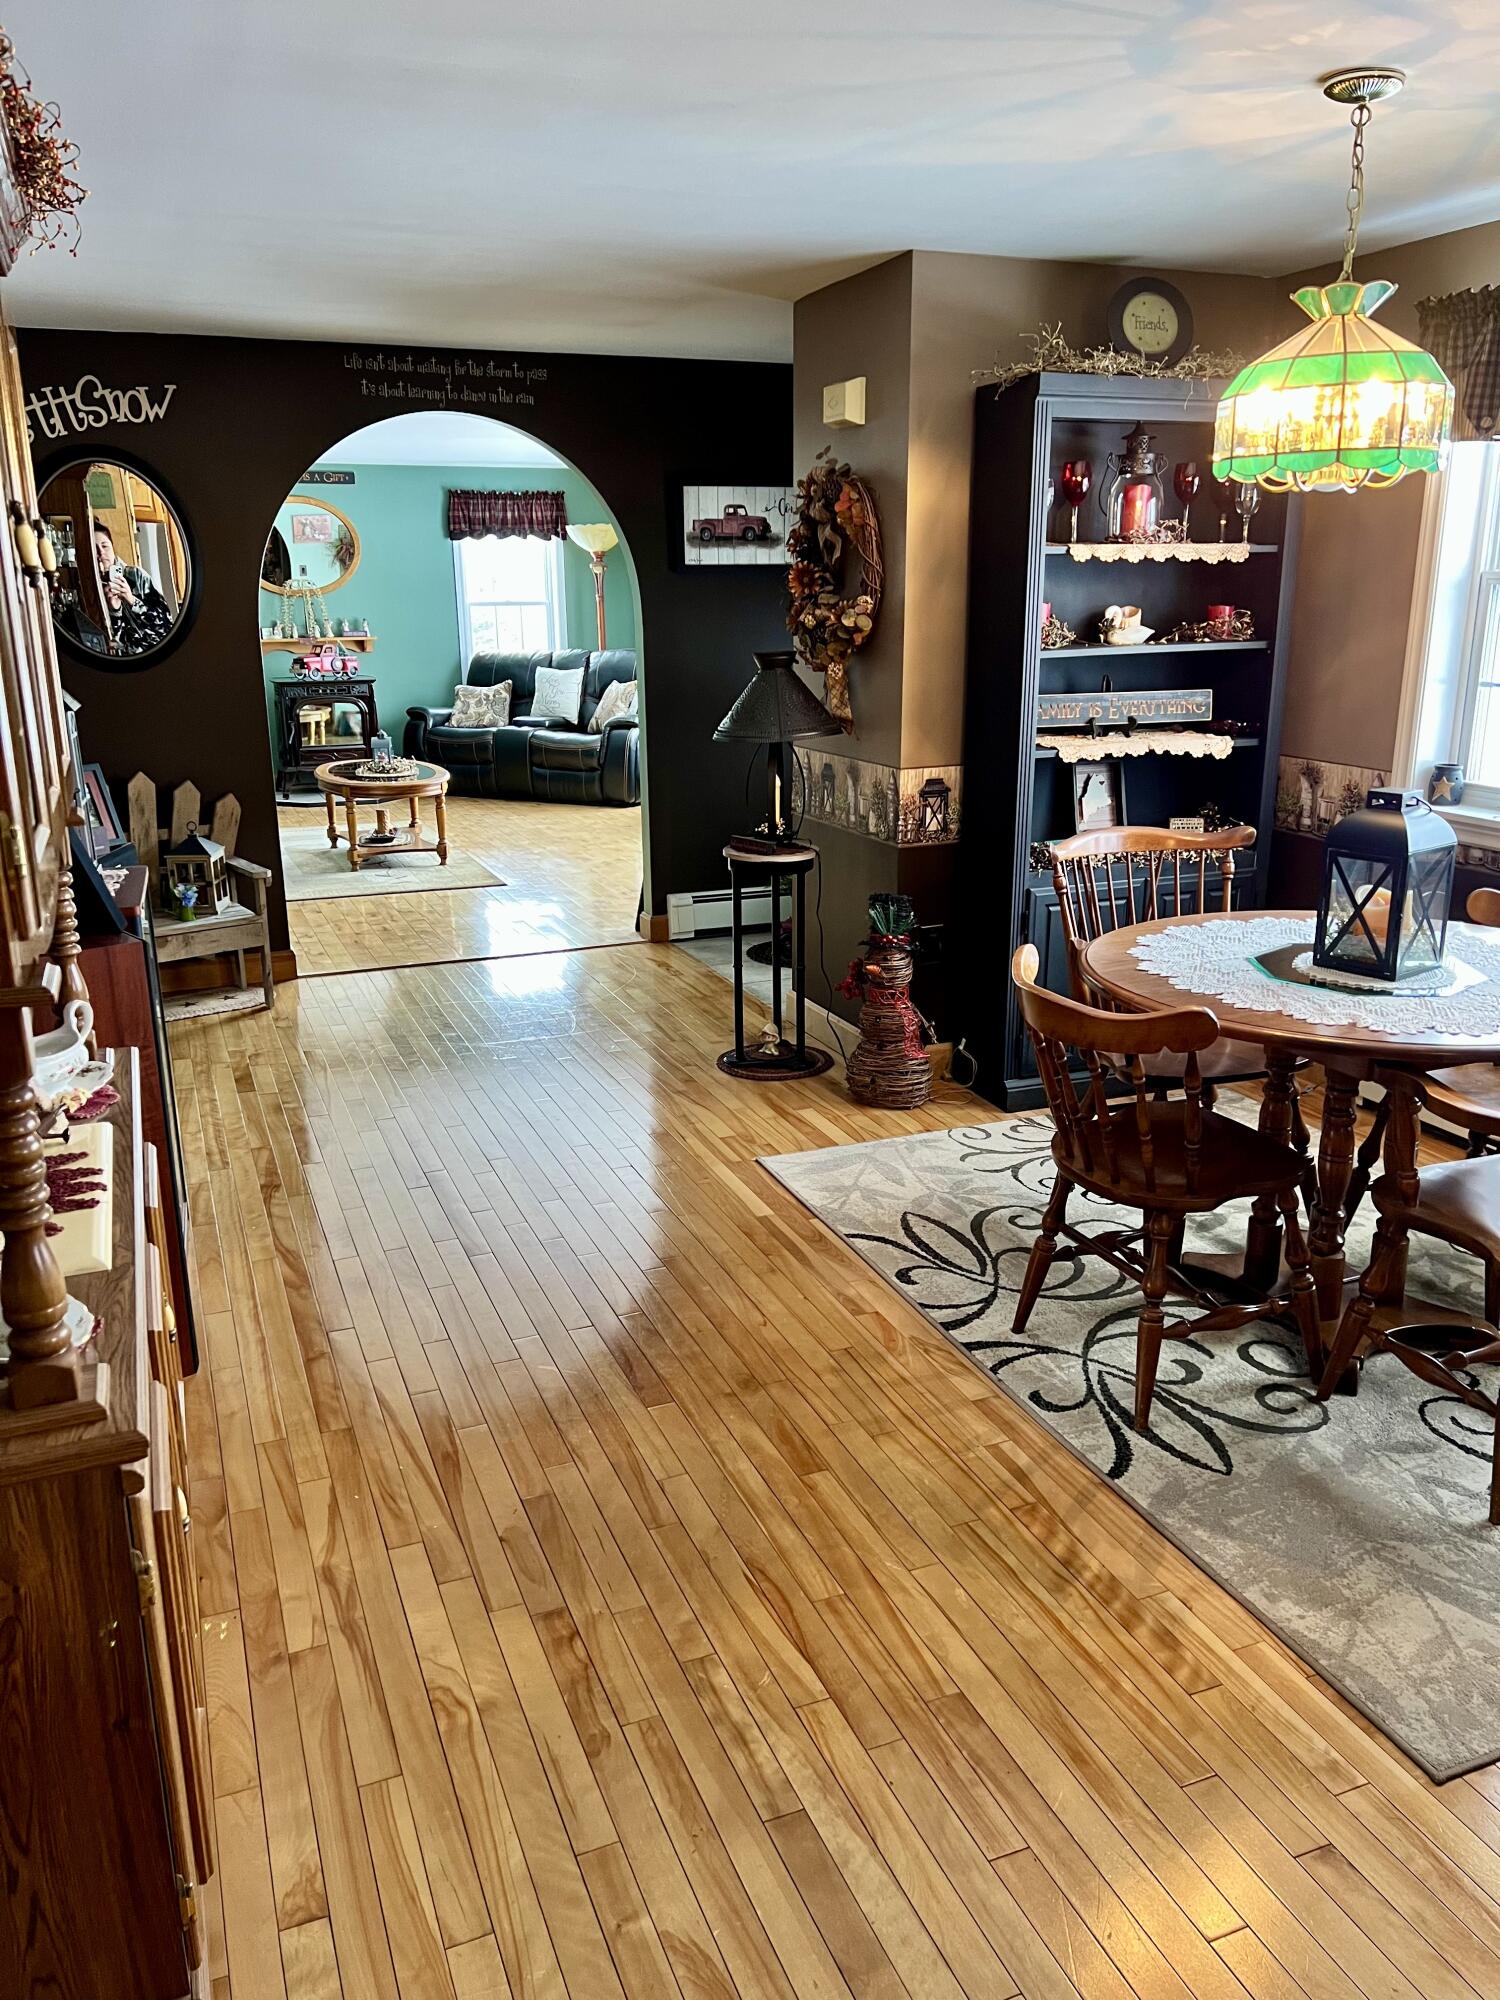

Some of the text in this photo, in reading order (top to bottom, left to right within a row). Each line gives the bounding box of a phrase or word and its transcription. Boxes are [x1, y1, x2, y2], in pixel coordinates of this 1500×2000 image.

[344, 353, 547, 384] Life isn't about waiting for the storm to pass
[361, 379, 535, 408] it's about learning to dance in the rain
[1038, 703, 1082, 719] AMILY
